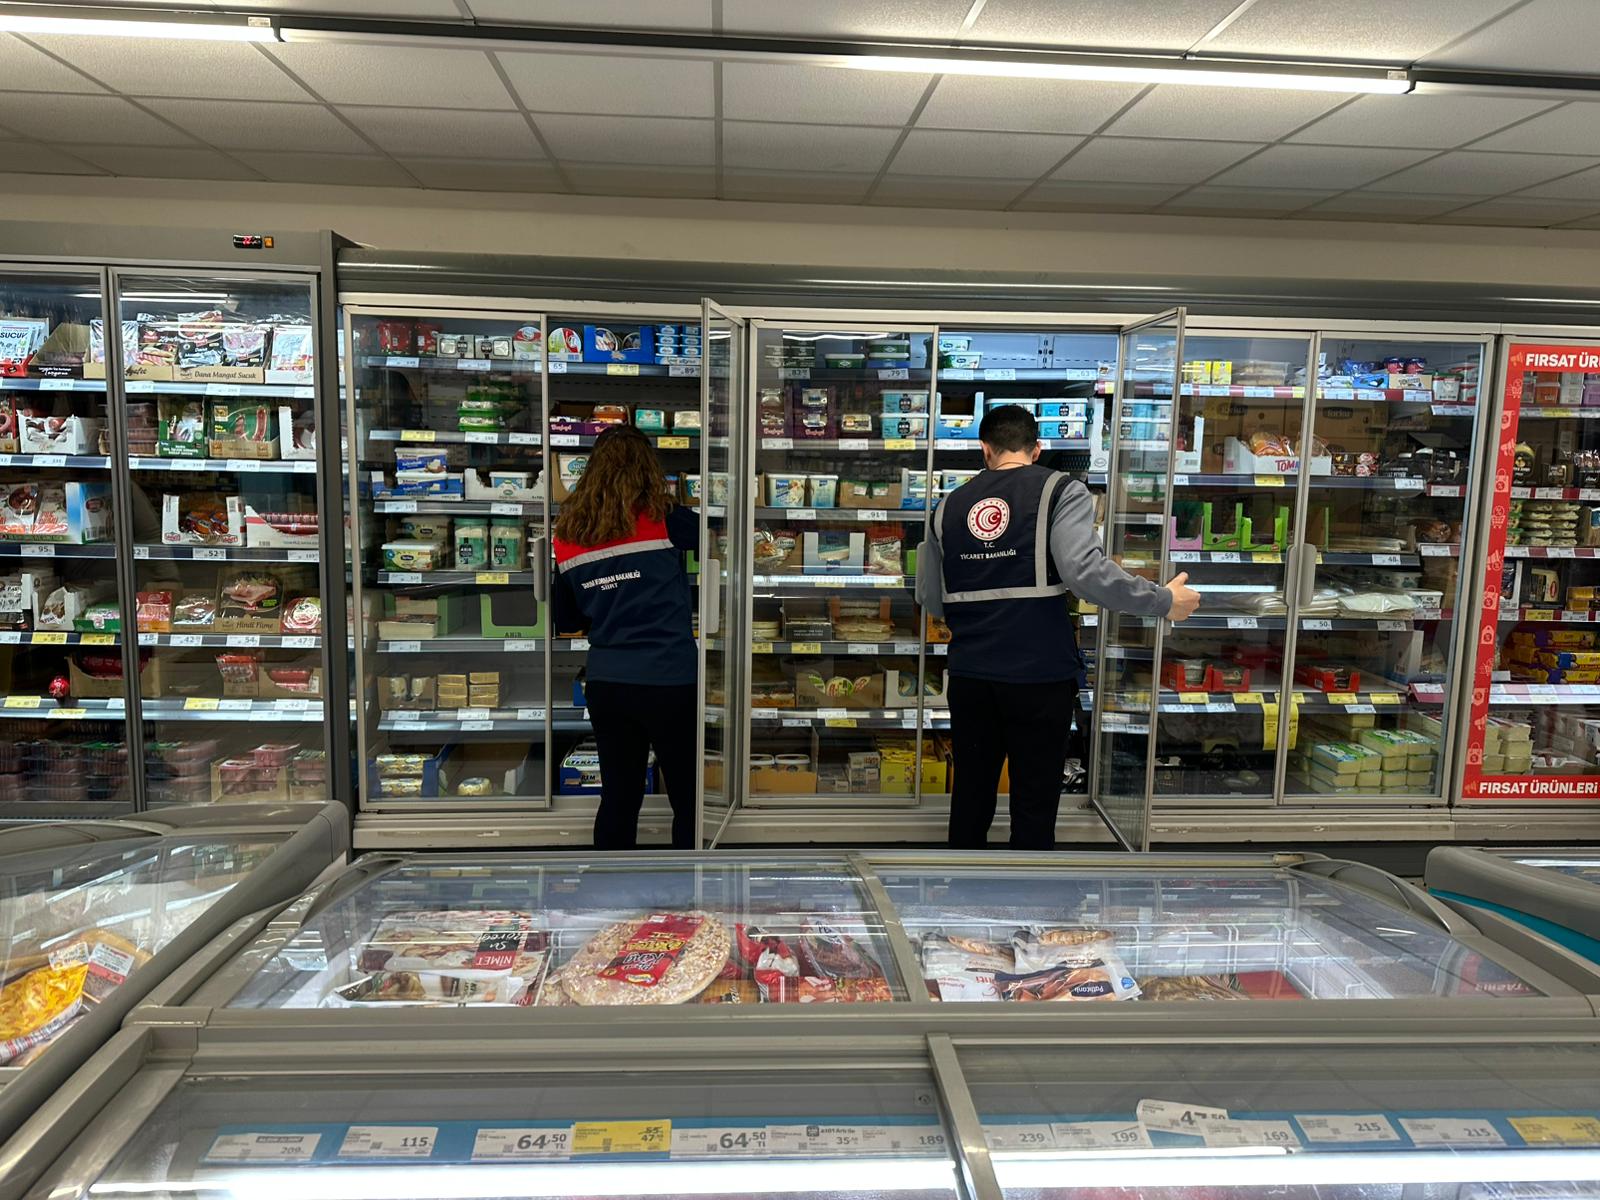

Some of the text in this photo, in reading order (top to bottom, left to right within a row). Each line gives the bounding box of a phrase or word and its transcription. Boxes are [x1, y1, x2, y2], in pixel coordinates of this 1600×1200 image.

[1525, 351, 1600, 368] FIRSAT ÜR
[38, 545, 48, 553] 95
[1479, 782, 1528, 794] FIRSAT
[476, 955, 513, 966] NİMET
[1354, 1122, 1381, 1132] 215
[1463, 1127, 1490, 1137] 215
[919, 1135, 944, 1146] 189
[1019, 1132, 1045, 1143] 239
[1112, 1132, 1138, 1143] 199
[1263, 1131, 1289, 1141] 169
[400, 1137, 428, 1147] 115
[280, 1146, 301, 1155] 209
